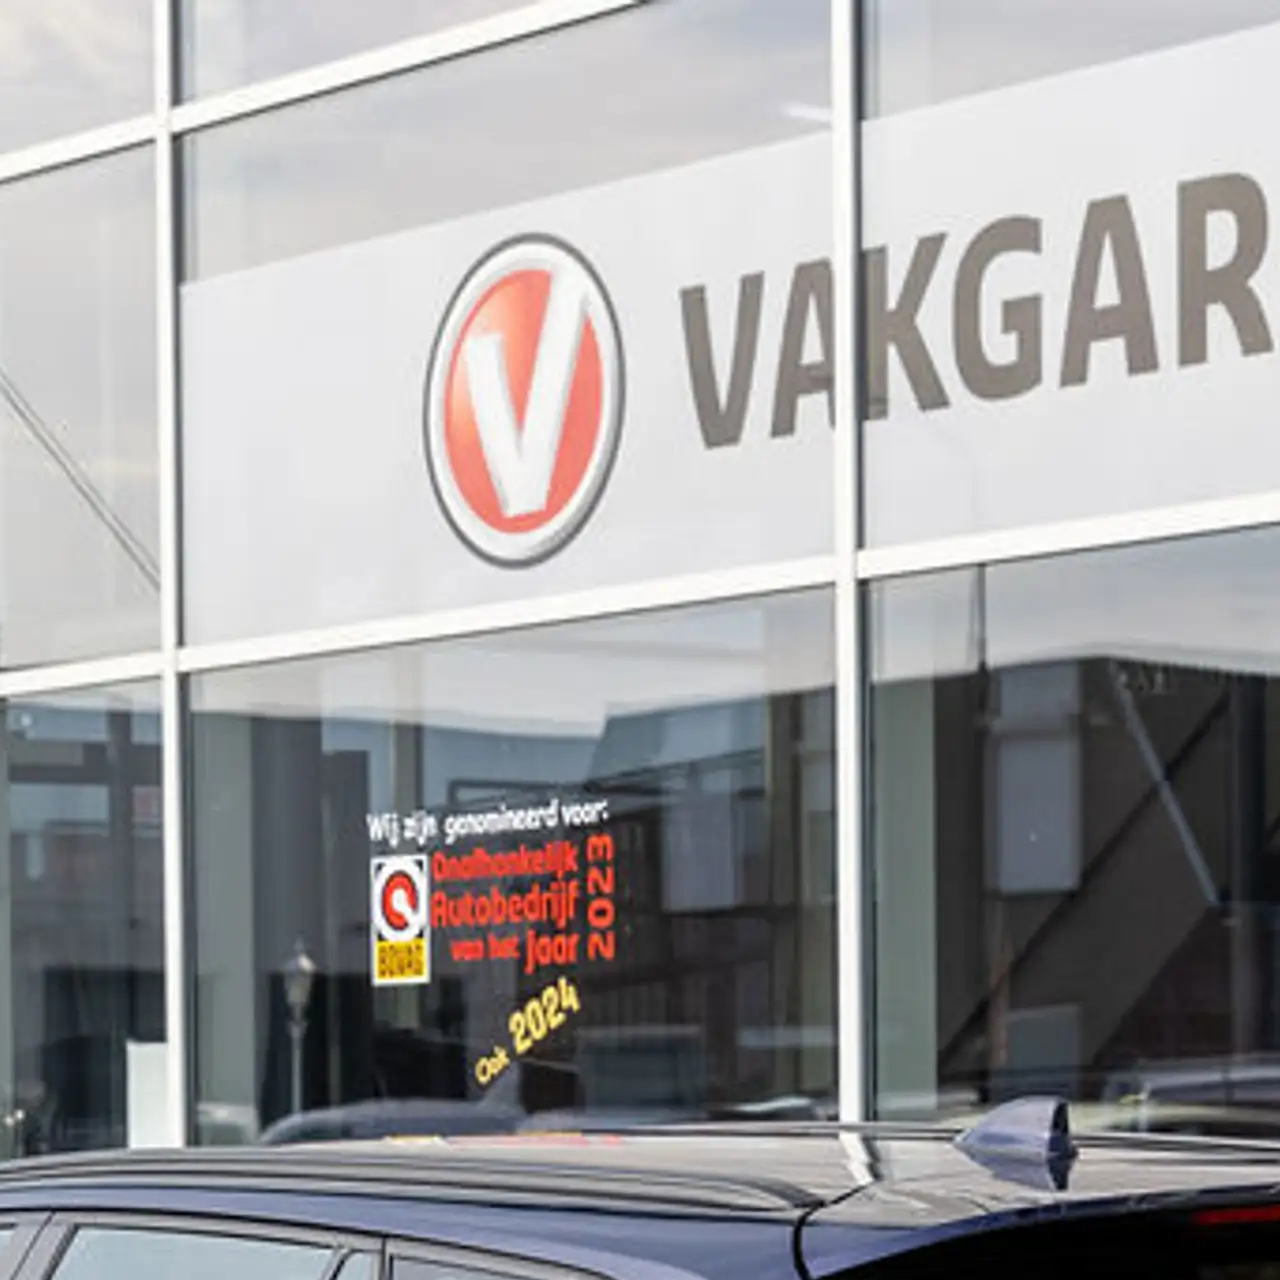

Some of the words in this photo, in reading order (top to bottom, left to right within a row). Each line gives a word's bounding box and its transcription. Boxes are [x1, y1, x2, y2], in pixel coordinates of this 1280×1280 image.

[366, 813, 399, 848] Wij
[444, 798, 558, 845] genomineerd
[431, 879, 580, 928] Autobedrijf
[586, 833, 616, 961] 2023
[474, 1046, 510, 1085] Ook
[508, 976, 581, 1053] 2024
